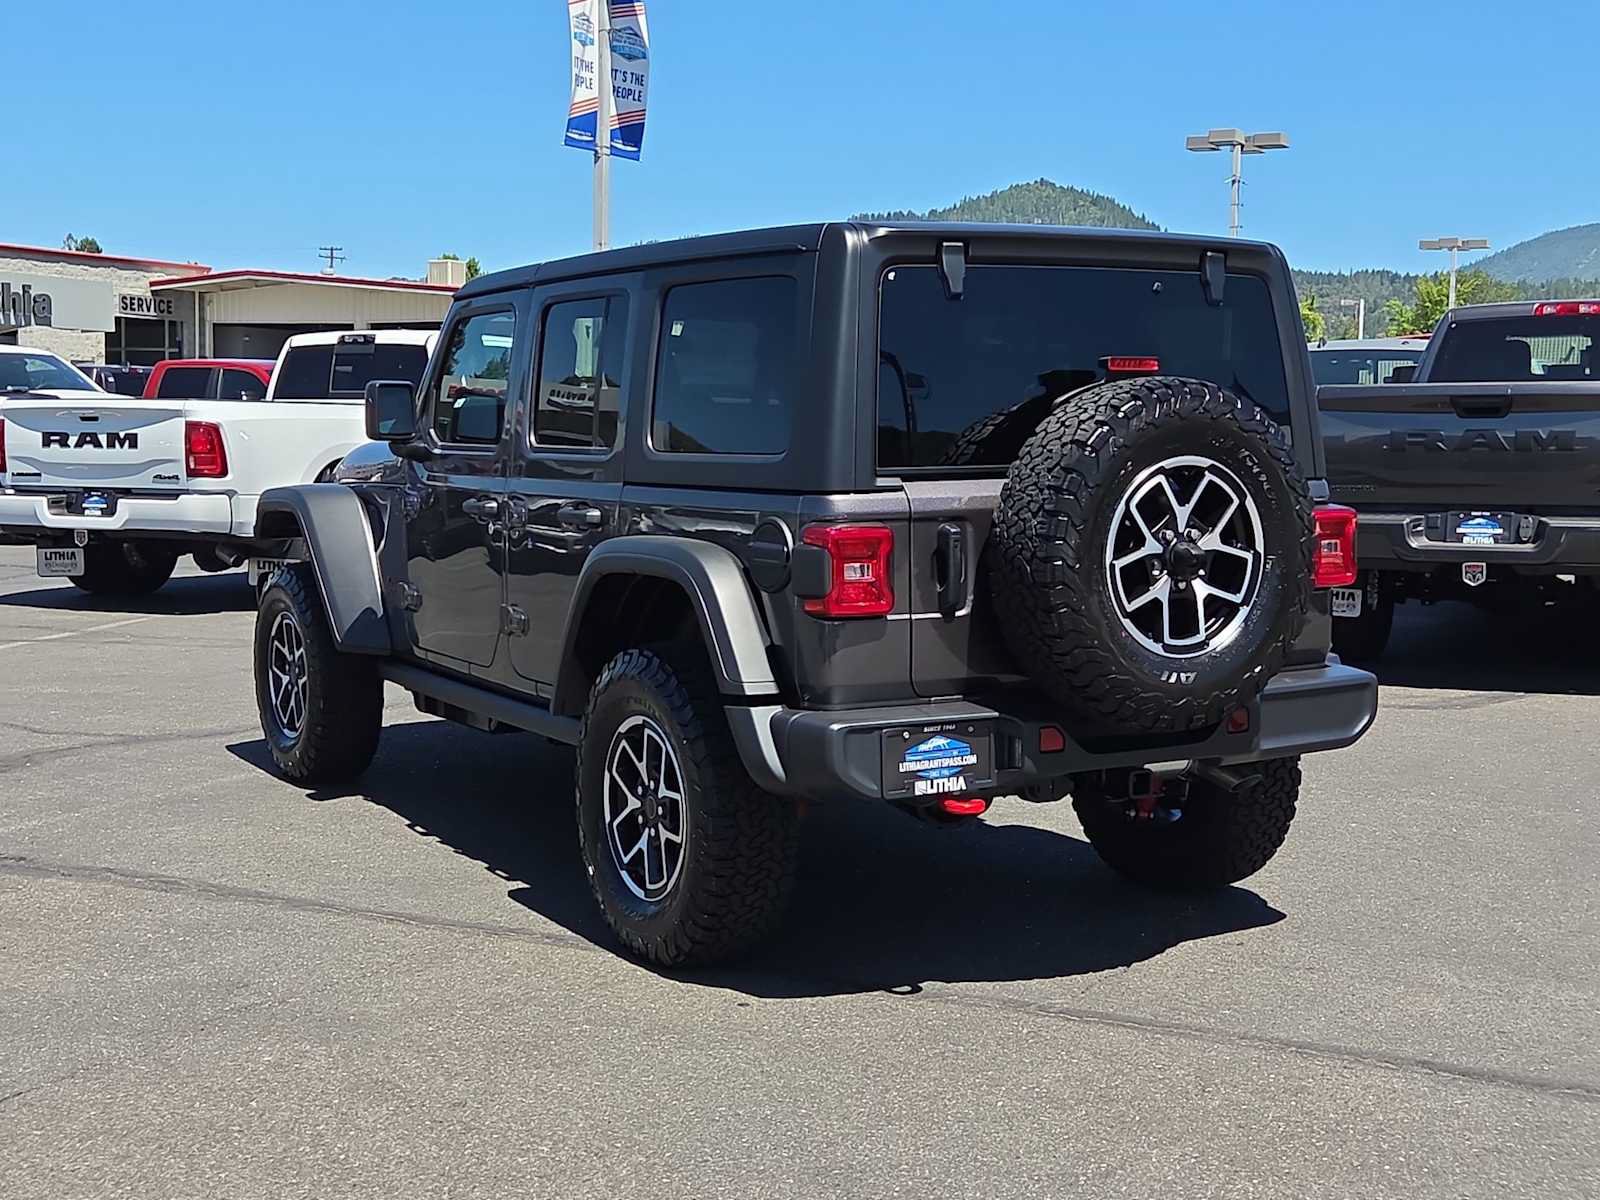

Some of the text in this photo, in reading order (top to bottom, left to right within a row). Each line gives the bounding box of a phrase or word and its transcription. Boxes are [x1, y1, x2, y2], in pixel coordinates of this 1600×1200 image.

[630, 72, 645, 87] THE
[612, 85, 643, 103] PEOPLE
[0, 282, 52, 327] hia
[121, 295, 173, 315] SERVICE
[41, 431, 139, 449] RAM
[1384, 428, 1586, 451] RAM
[44, 551, 77, 560] LITHIA
[1331, 590, 1356, 601] HIA
[927, 776, 967, 795] LITHIA
